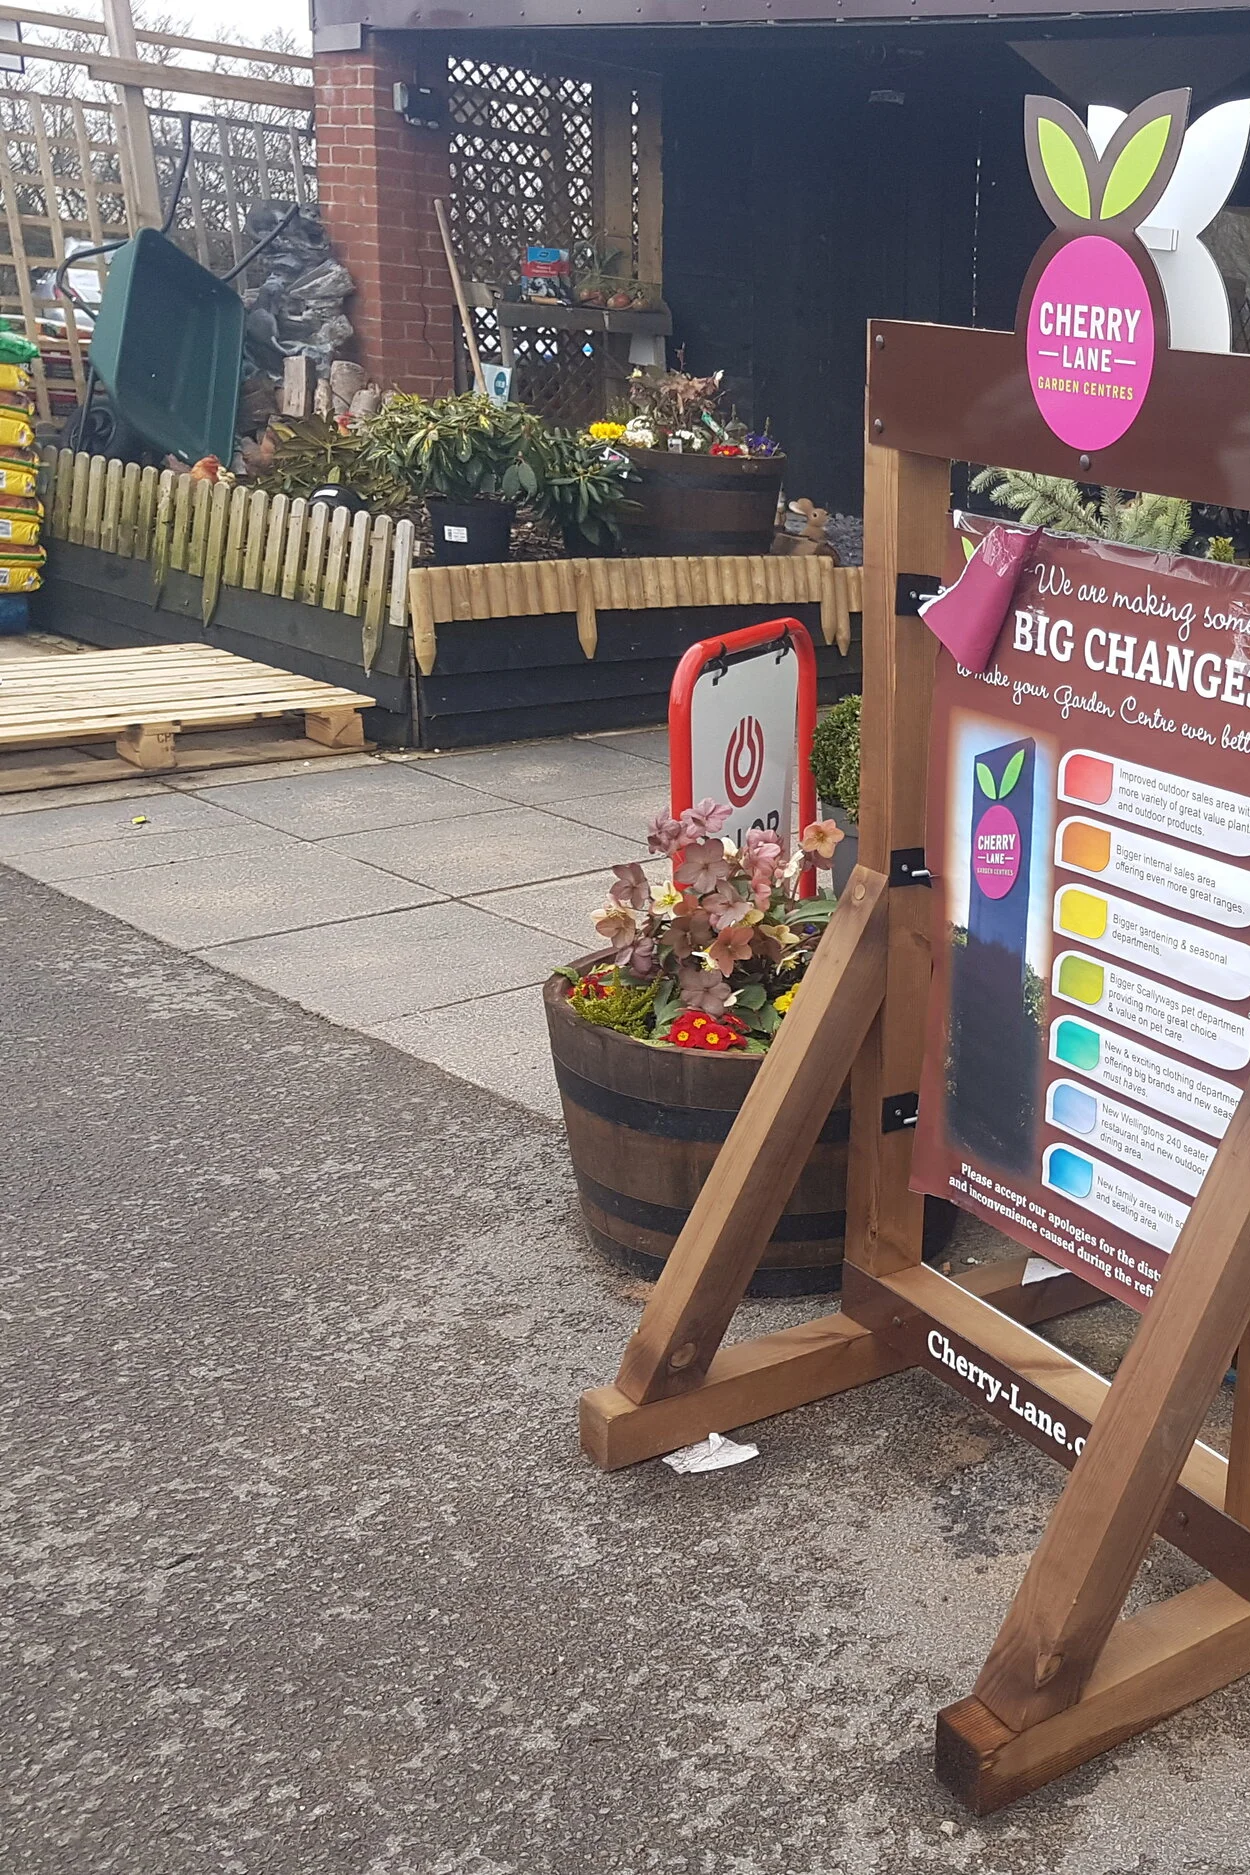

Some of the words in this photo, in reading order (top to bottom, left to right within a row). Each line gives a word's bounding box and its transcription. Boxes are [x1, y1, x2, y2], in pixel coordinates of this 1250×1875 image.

[1039, 301, 1141, 343] CHERRY
[1062, 345, 1112, 373] LANE
[1038, 376, 1079, 394] GARDEN
[1083, 382, 1133, 401] CENTRES
[1034, 563, 1073, 596] We
[1078, 584, 1108, 604] are
[1112, 585, 1196, 641] making
[1013, 610, 1075, 662] BIG
[1012, 680, 1049, 705] your
[1054, 685, 1115, 719] Garden
[1120, 696, 1176, 732] Centre
[1181, 718, 1216, 746] even
[1119, 786, 1139, 799] more
[1141, 792, 1168, 810] variety
[1169, 800, 1178, 810] of
[1179, 804, 1201, 818] great
[1203, 811, 1225, 826] value
[1120, 768, 1156, 788] Improved
[1158, 781, 1190, 798] outdoor
[1192, 792, 1214, 806] sales
[1216, 800, 1235, 812] area
[1118, 801, 1133, 813] and
[1135, 805, 1165, 822] outdoor
[1167, 816, 1205, 836] products.
[978, 834, 1016, 850] CHERRY
[986, 853, 1005, 864] LANE
[1116, 844, 1141, 861] Bigger
[1144, 852, 1172, 872] internal
[1174, 866, 1195, 881] sales
[1197, 874, 1216, 888] area
[1116, 862, 1144, 880] offering
[1146, 872, 1165, 886] even
[1167, 879, 1188, 894] more
[1190, 888, 1211, 903] great
[1213, 894, 1245, 915] ranges.
[1108, 989, 1143, 1012] providing
[1145, 1003, 1165, 1019] more
[1167, 1014, 1189, 1029] great
[1190, 1022, 1217, 1040] choice
[1108, 1002, 1113, 1012] &
[1116, 1007, 1136, 1021] value
[1138, 1017, 1148, 1026] on
[1150, 1021, 1163, 1033] pet
[1164, 1028, 1184, 1042] care.
[1110, 973, 1135, 991] Bigger
[1136, 983, 1179, 1010] Scallywags
[1182, 1004, 1196, 1017] pet
[1197, 1010, 1245, 1036] department
[949, 1176, 967, 1192] and
[969, 1184, 1038, 1232] inconvenience
[1040, 1225, 1075, 1253] caused
[1077, 1246, 1112, 1278] during
[1114, 1266, 1132, 1286] the
[961, 1162, 992, 1188] Please
[994, 1183, 1026, 1208] accept
[1028, 1202, 1046, 1217] our
[1048, 1212, 1097, 1246] apologies
[1099, 1238, 1115, 1256] for
[1117, 1248, 1135, 1268] the
